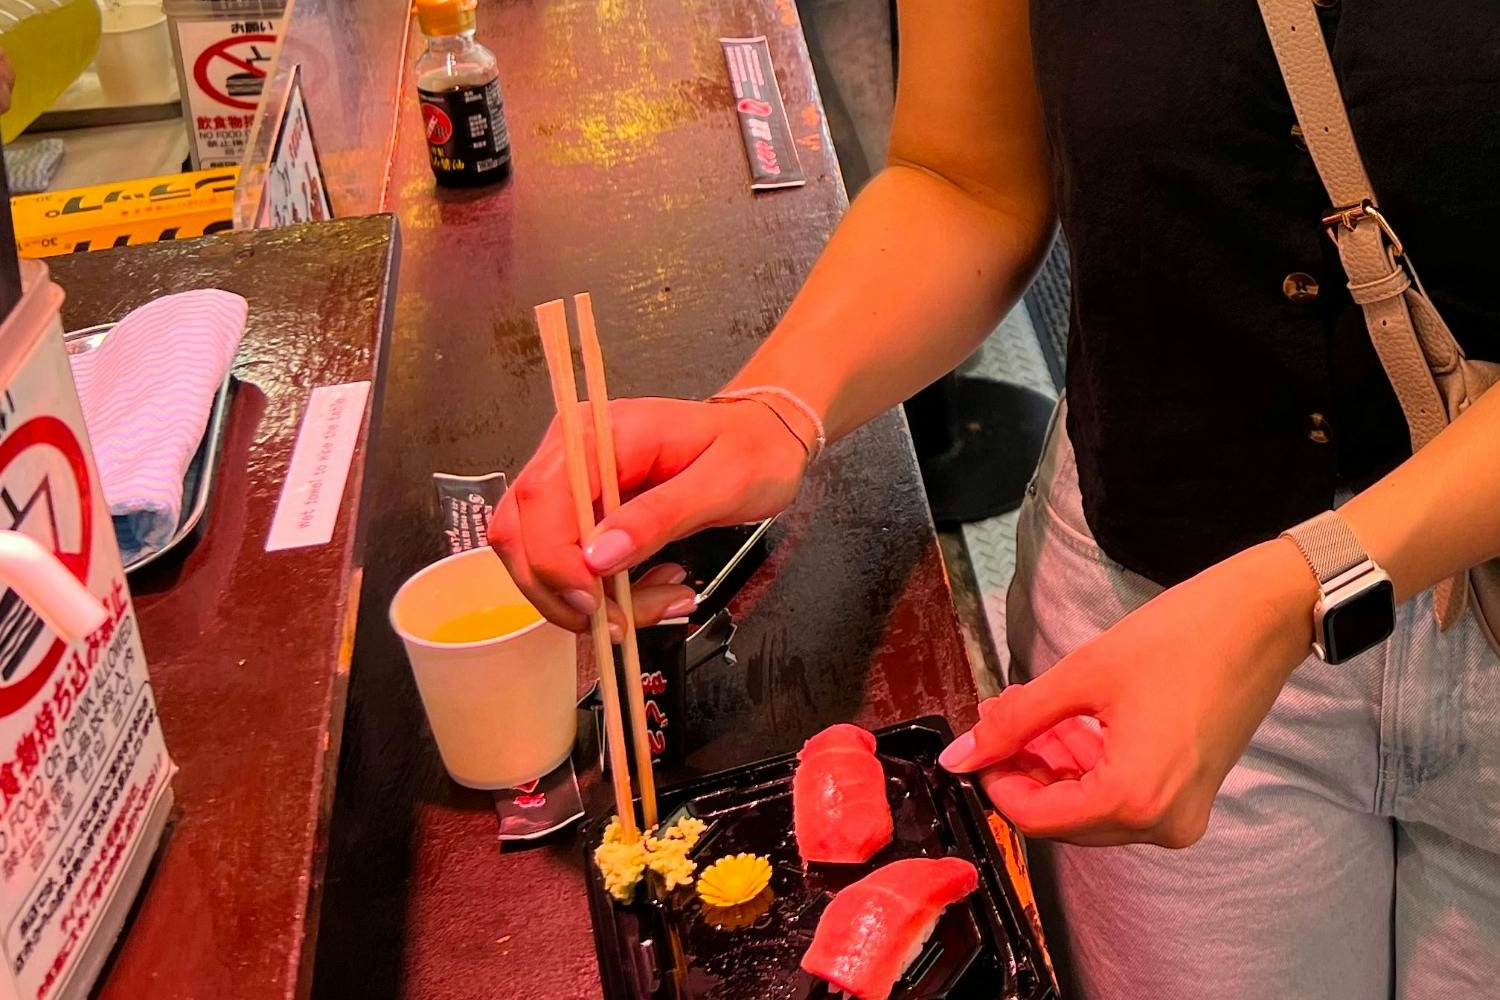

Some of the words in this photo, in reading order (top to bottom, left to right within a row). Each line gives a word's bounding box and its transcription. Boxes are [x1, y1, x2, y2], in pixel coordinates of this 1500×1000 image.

[231, 21, 273, 34] お願い
[199, 131, 214, 139] NO
[216, 130, 242, 138] FOOD
[9, 776, 44, 836] FOOD
[44, 743, 62, 779] OR
[63, 687, 96, 751] DRINK
[94, 614, 133, 699] ALLOWED
